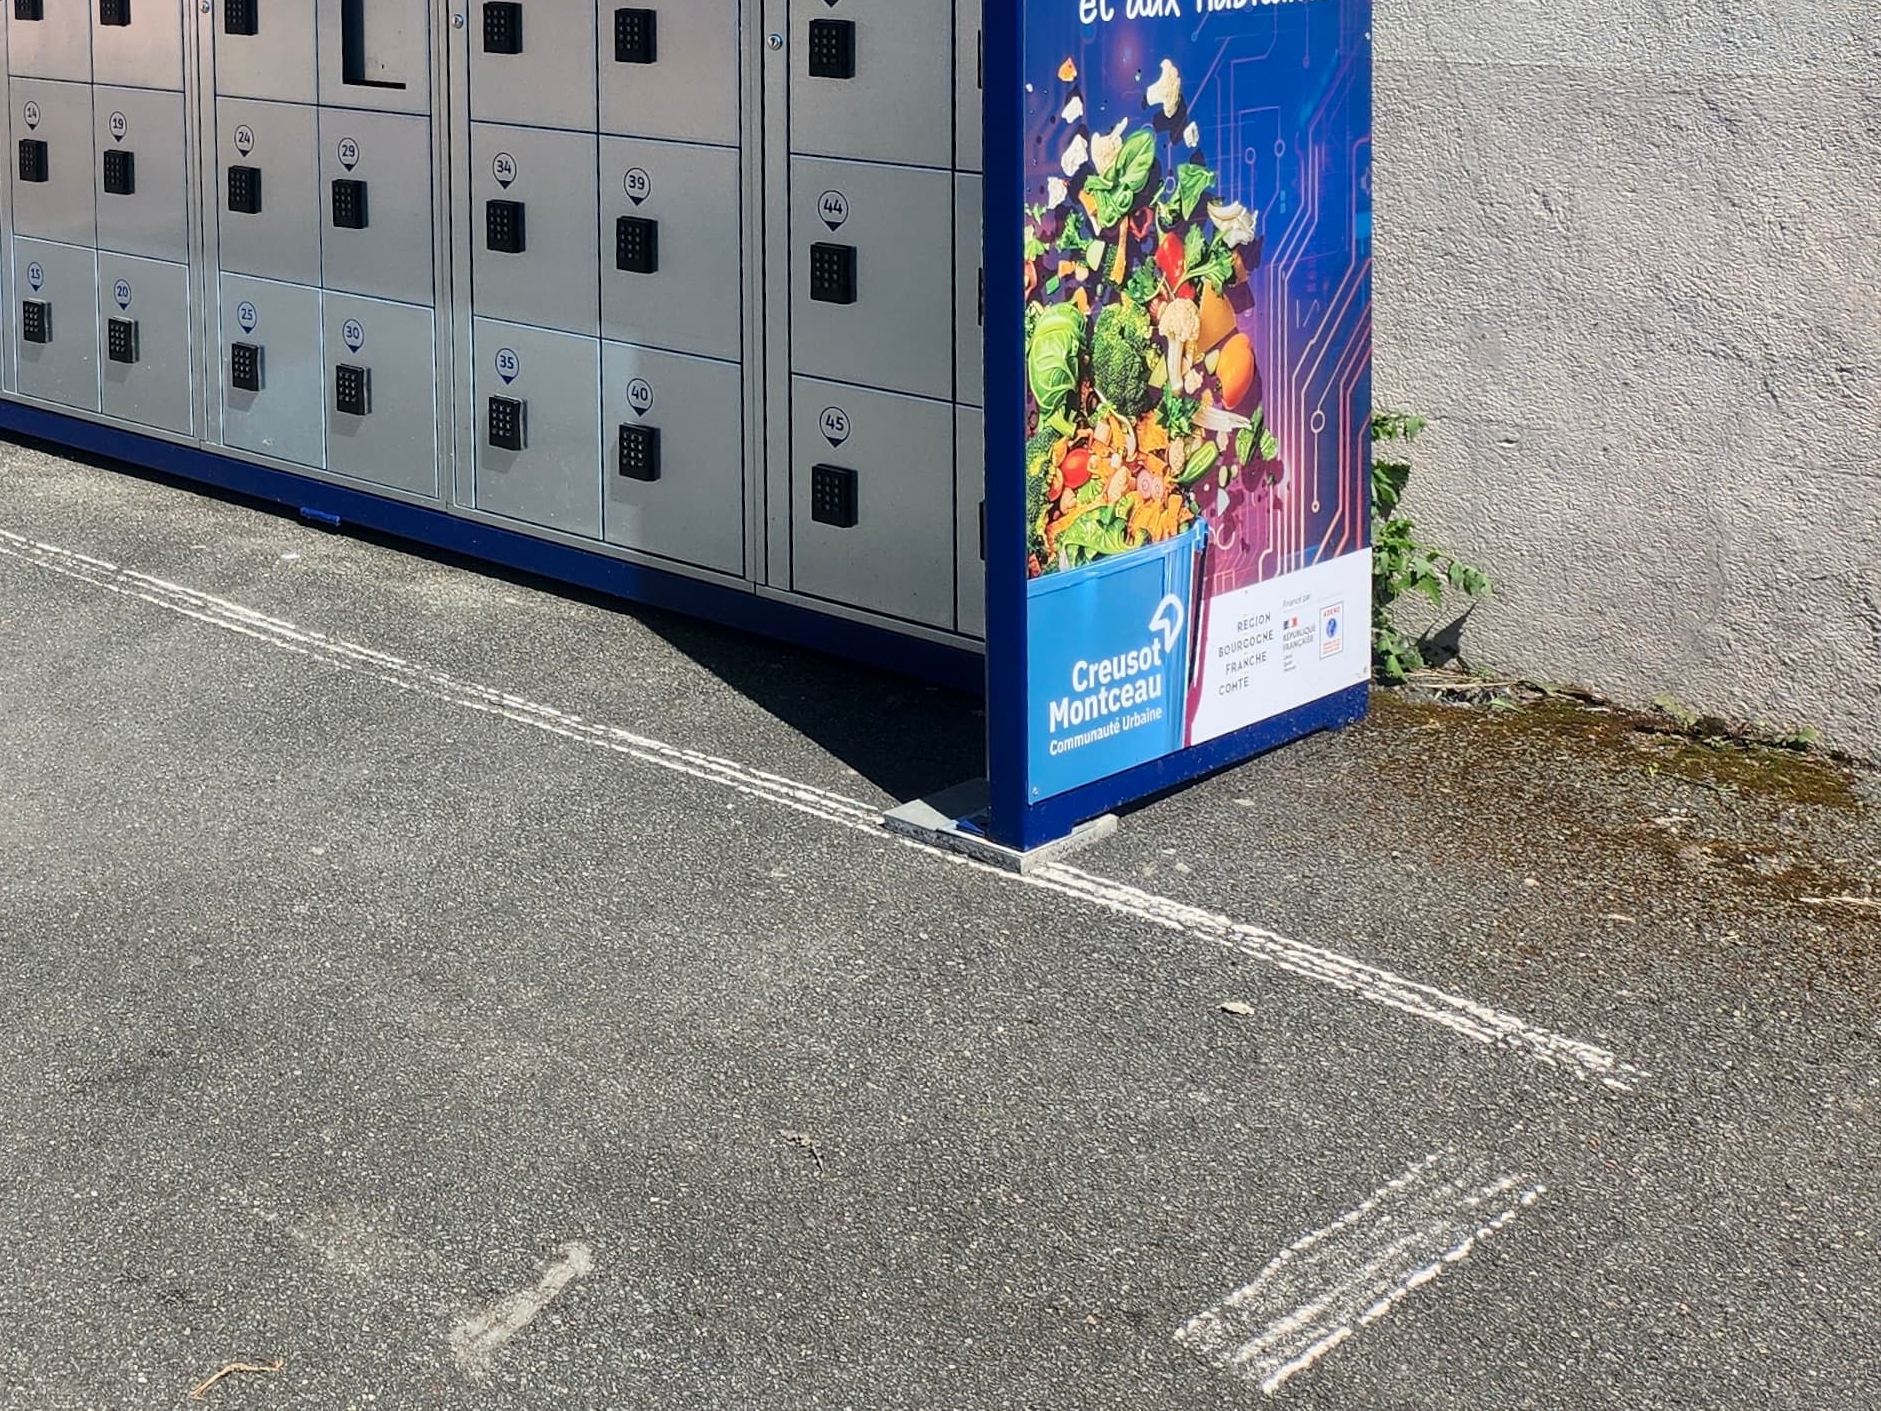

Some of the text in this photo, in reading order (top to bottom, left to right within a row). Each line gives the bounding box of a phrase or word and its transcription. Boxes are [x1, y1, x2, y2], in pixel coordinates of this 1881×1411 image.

[26, 106, 39, 120] 14
[111, 117, 125, 132] 19
[238, 131, 252, 144] 24
[342, 144, 357, 158] 29
[497, 160, 514, 175] 34
[628, 174, 646, 191] 39
[823, 198, 844, 215] 44
[31, 267, 42, 280] 15
[117, 286, 130, 298] 20
[241, 308, 255, 321] 25
[345, 327, 361, 342] 30
[500, 355, 516, 370] 35
[631, 386, 649, 402] 40
[825, 413, 846, 432] 45
[1218, 630, 1274, 658] BOURGOGNE
[1072, 637, 1162, 693] Creusot
[1225, 651, 1268, 675] FRANCHE
[1218, 677, 1249, 696] COMTE
[1049, 673, 1162, 734] Montceau
[1049, 707, 1163, 756] Communauté Urbaine
